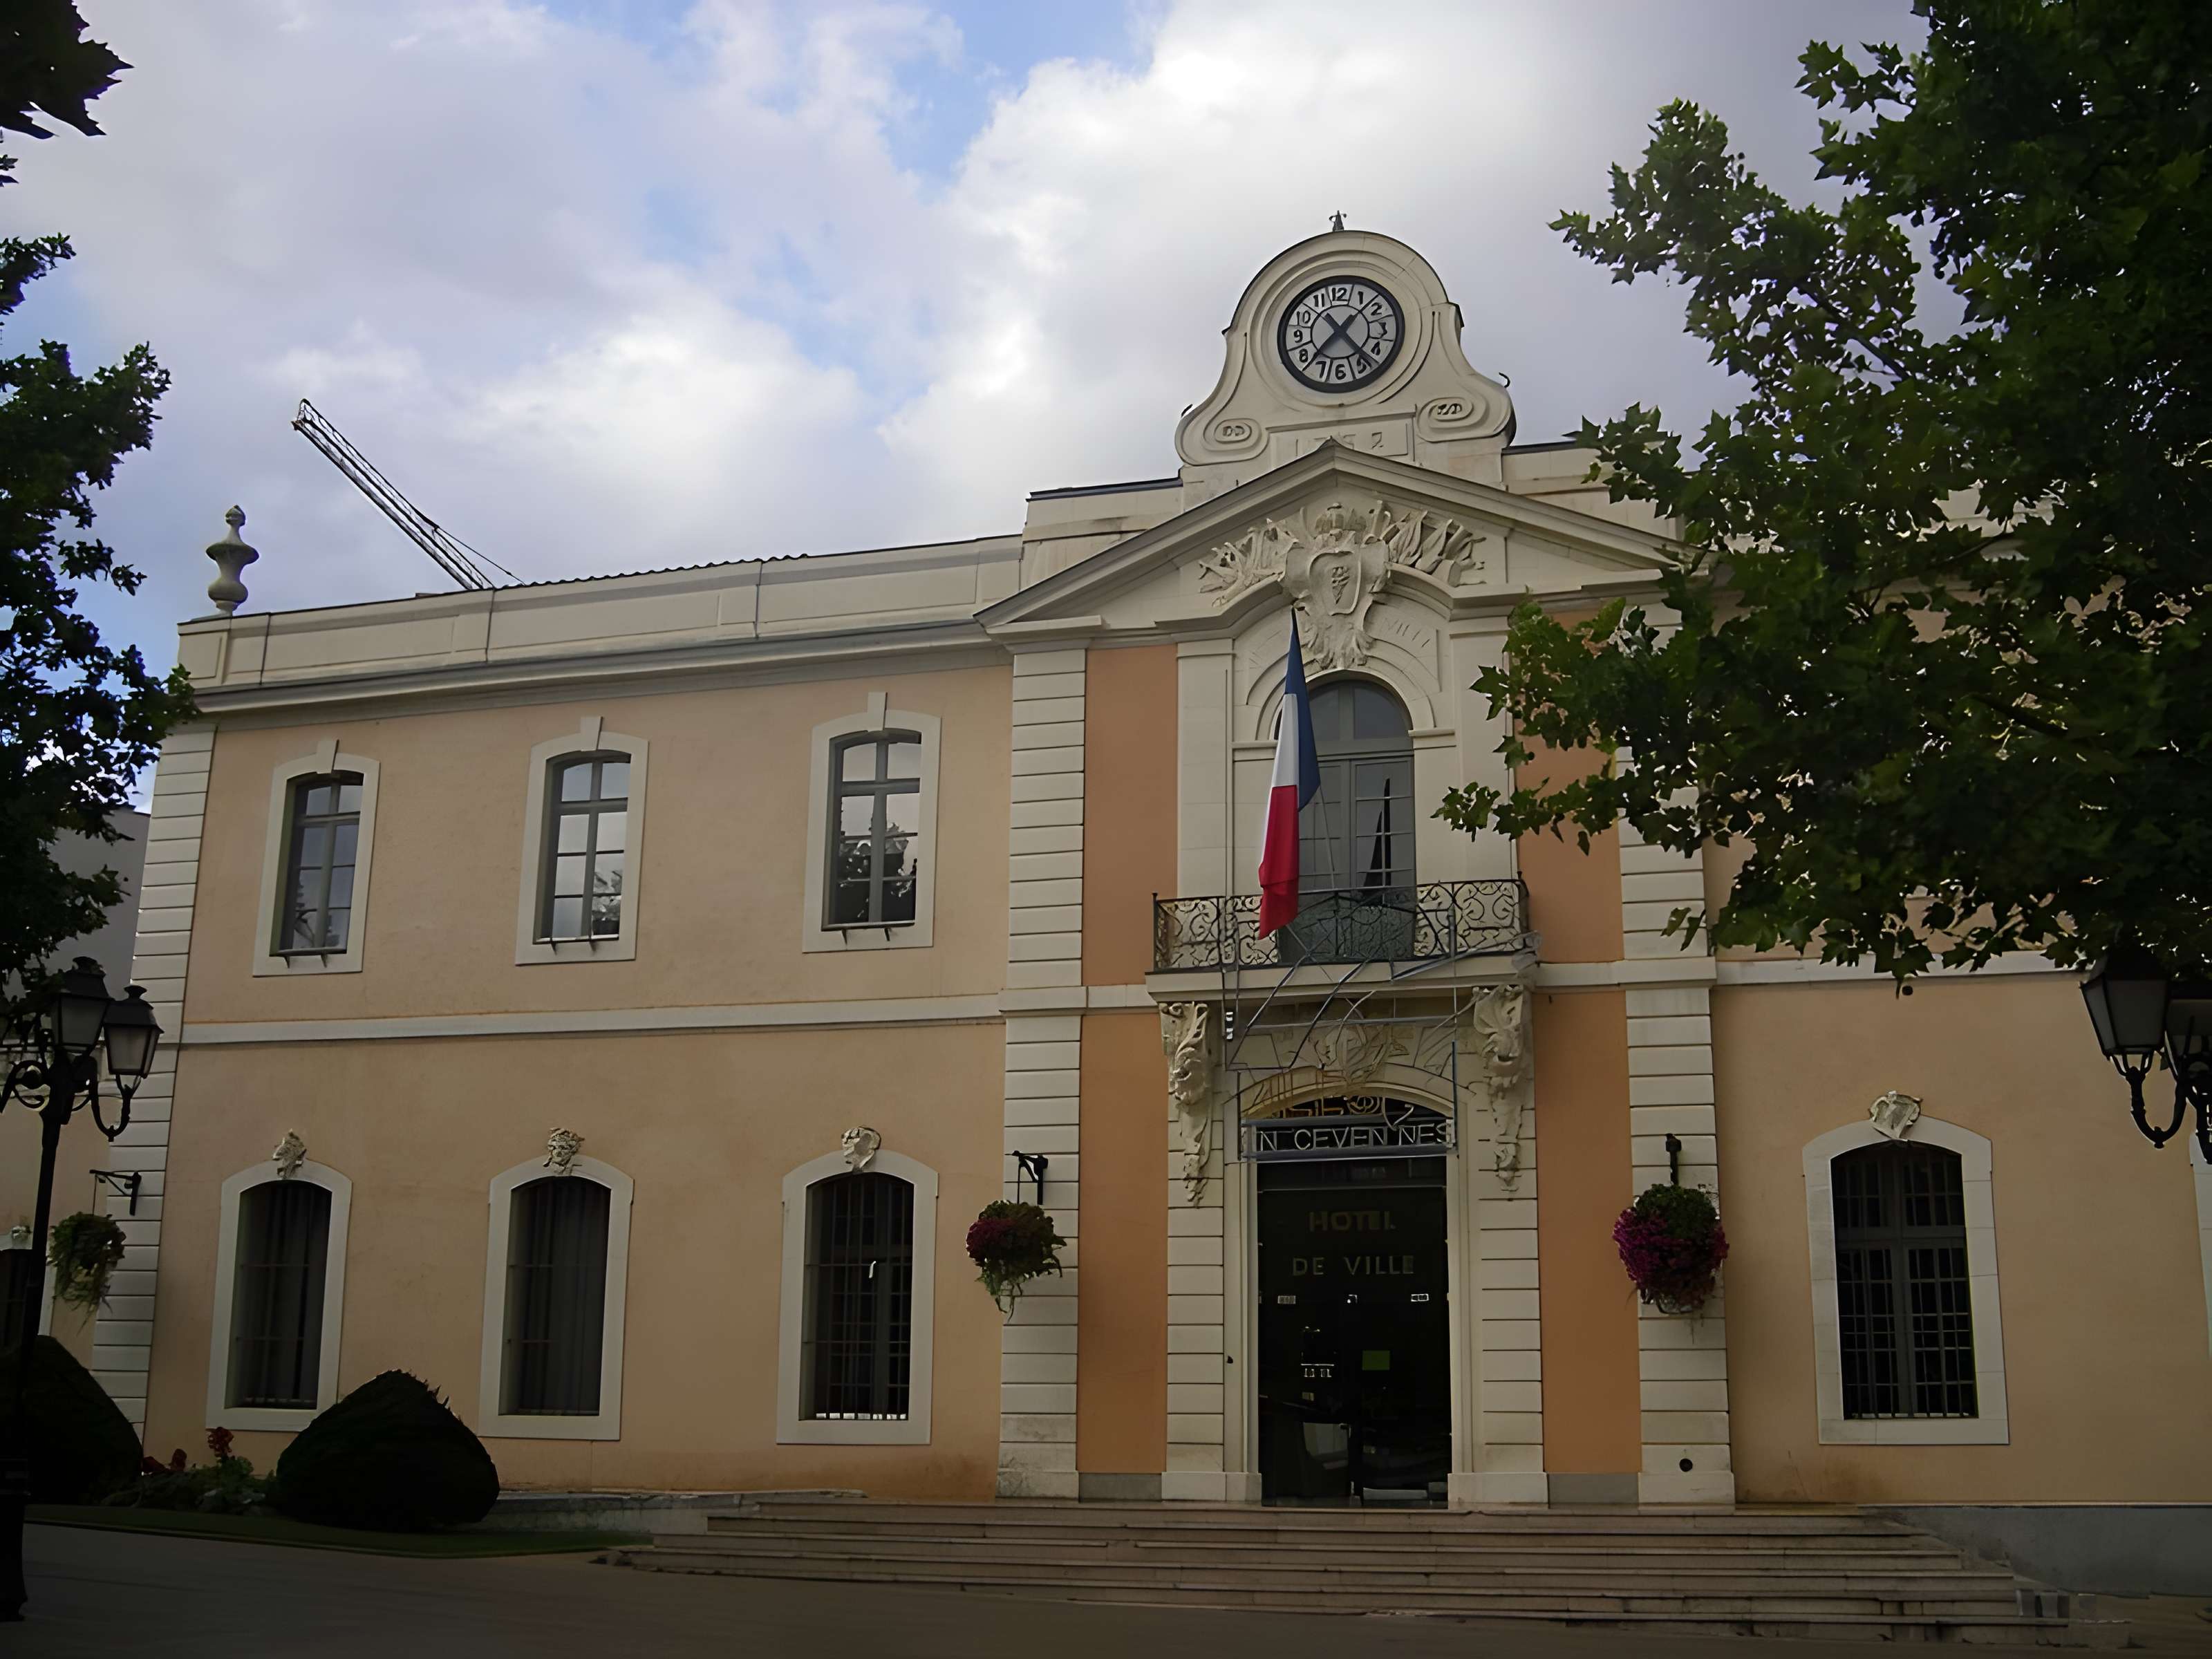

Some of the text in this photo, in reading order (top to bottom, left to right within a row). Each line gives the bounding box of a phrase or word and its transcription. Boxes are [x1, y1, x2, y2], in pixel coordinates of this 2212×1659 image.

[1313, 293, 1325, 308] 11
[1331, 287, 1349, 302] 12
[1371, 302, 1382, 316] 2
[1297, 310, 1311, 326] 10
[1293, 330, 1303, 343] 9
[1299, 348, 1309, 363] 8
[1315, 361, 1327, 378] 7
[1335, 364, 1347, 380] 6
[1292, 1255, 1414, 1276] DE VILLE
